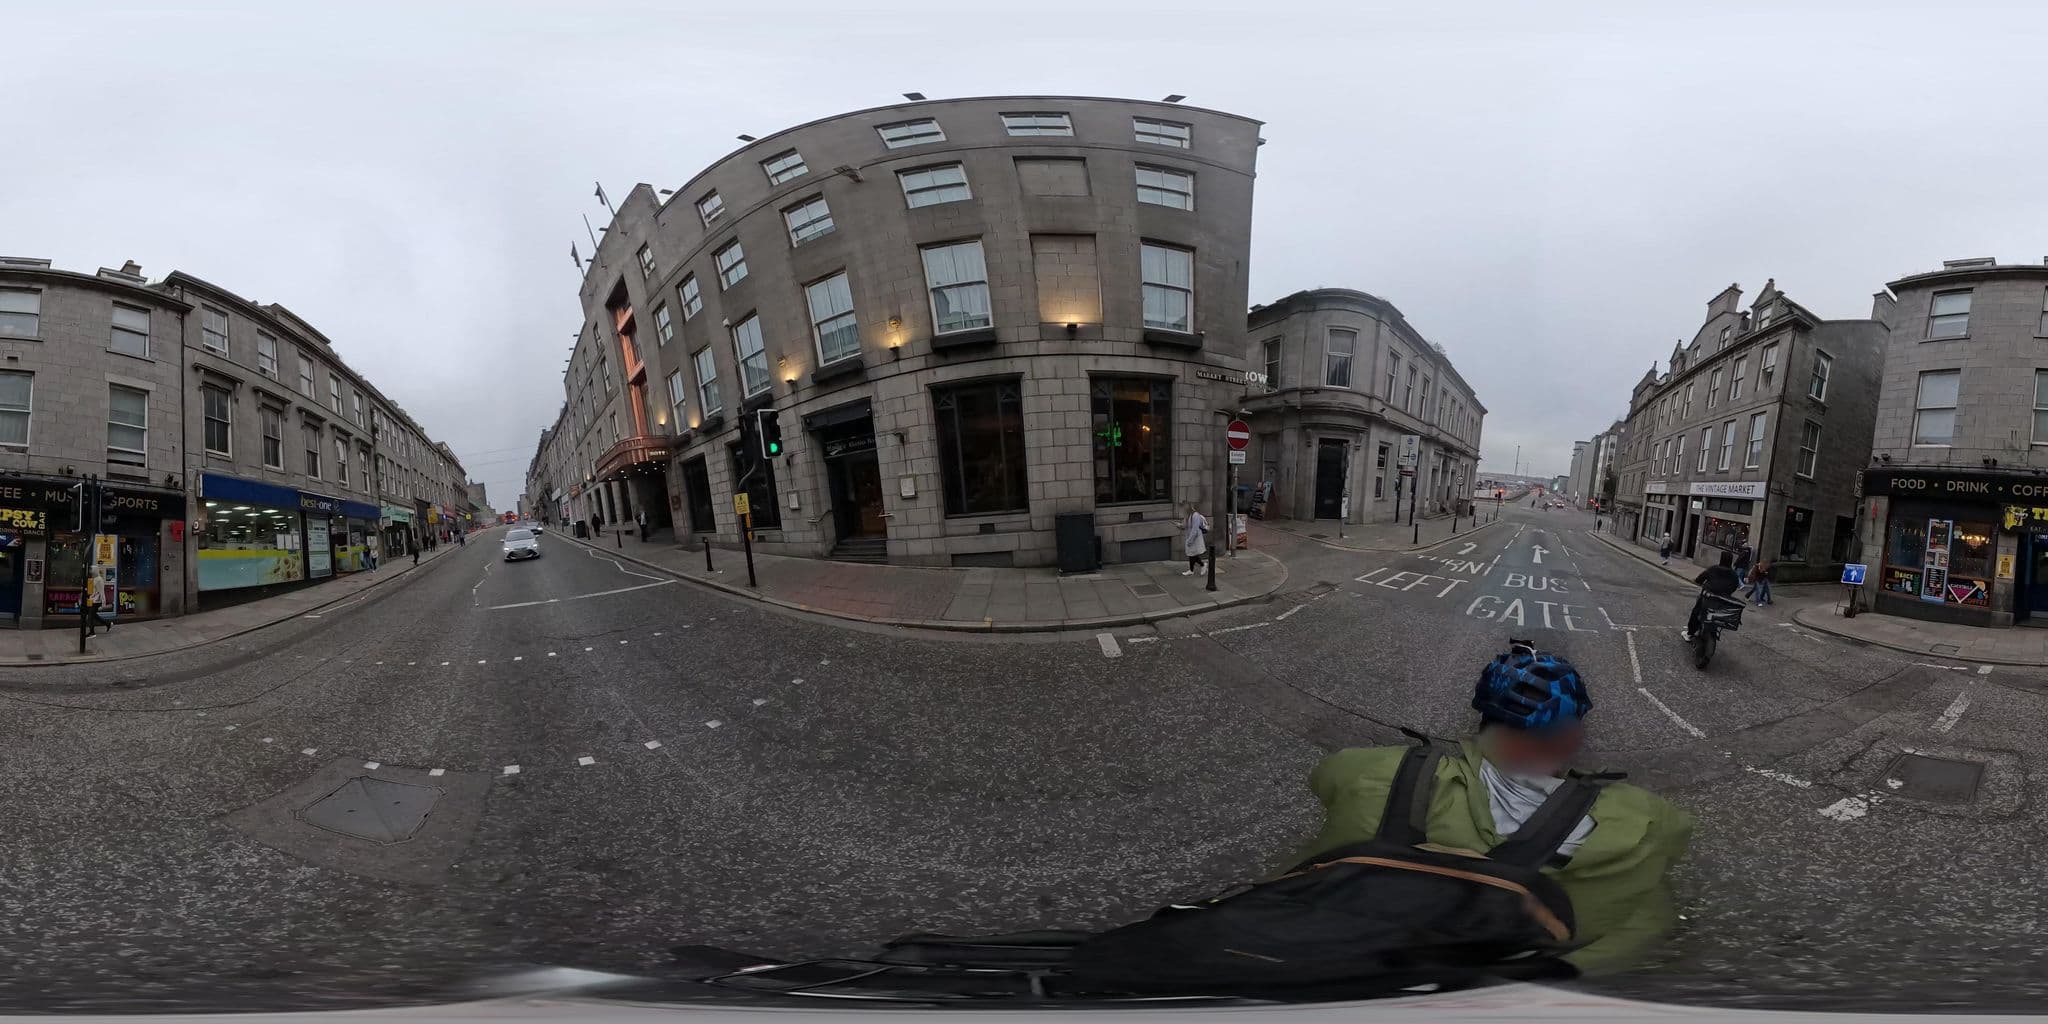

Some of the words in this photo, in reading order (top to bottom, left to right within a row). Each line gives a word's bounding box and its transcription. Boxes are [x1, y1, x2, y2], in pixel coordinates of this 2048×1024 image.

[1246, 371, 1268, 384] OW
[1728, 485, 1755, 495] MARKET
[1891, 478, 1927, 490] FOOD
[1947, 481, 1990, 494] DRINK
[111, 496, 158, 511] SPORTS
[12, 519, 38, 529] COW
[38, 512, 46, 529] BAR
[23, 529, 44, 537] DANCE
[1355, 567, 1469, 598] LEFT
[1502, 573, 1569, 594] BUS
[1466, 595, 1600, 633] GATE
